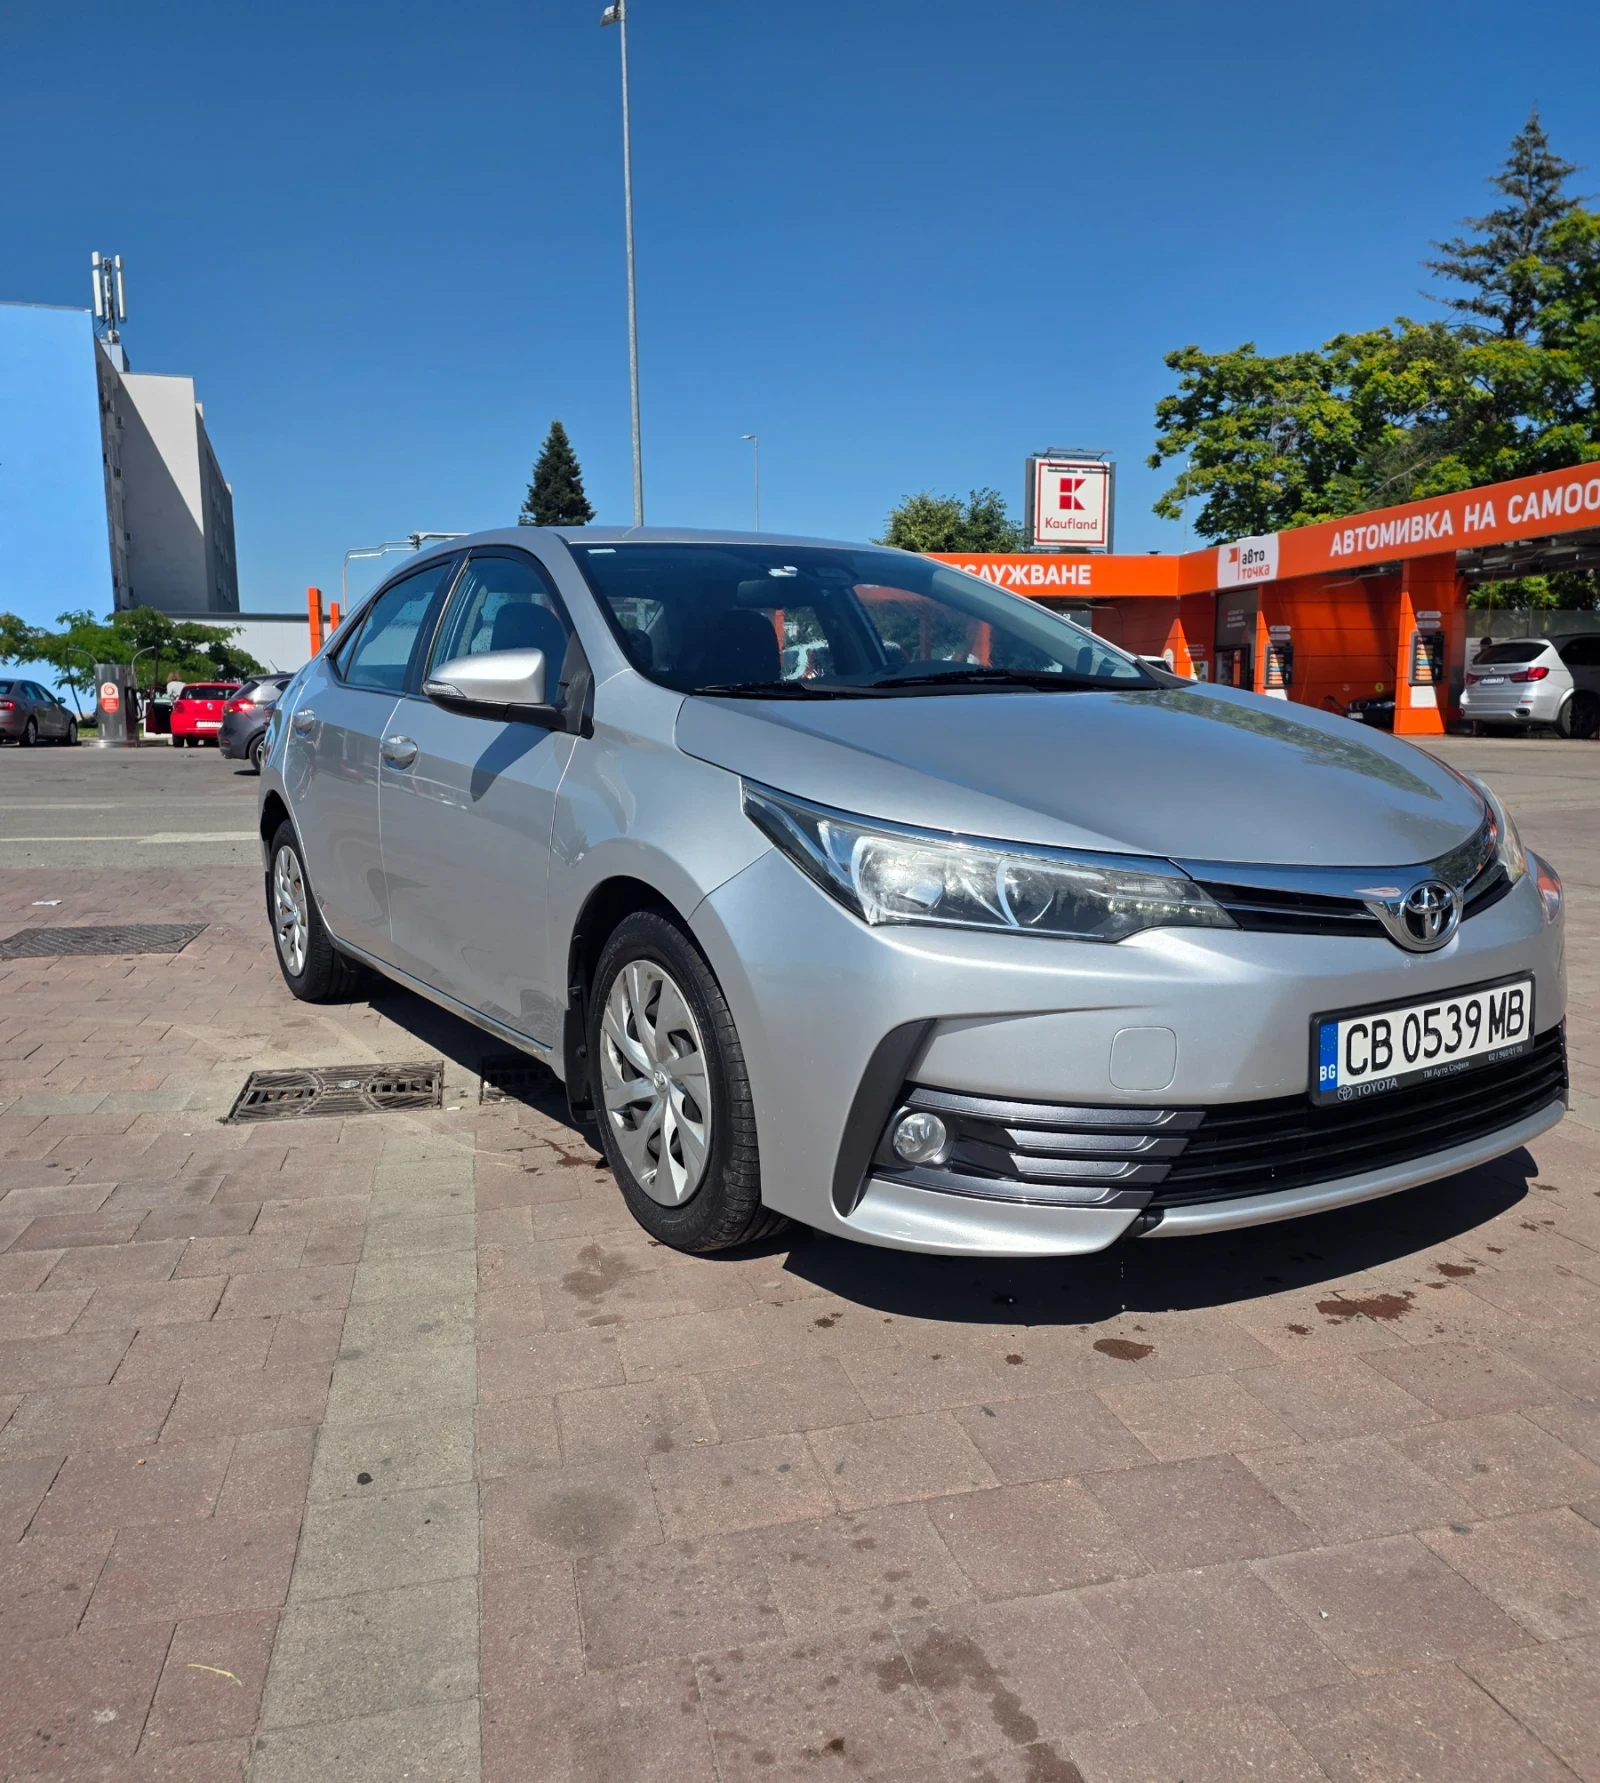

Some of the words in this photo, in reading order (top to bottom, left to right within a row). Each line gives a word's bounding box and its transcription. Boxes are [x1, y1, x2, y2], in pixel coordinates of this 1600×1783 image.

[1045, 516, 1098, 531] Kaufland
[1329, 508, 1454, 557] АВТОМИВКА
[1463, 500, 1497, 533] НА
[1241, 548, 1265, 565] авто
[1241, 564, 1270, 580] точка
[1345, 1018, 1394, 1076] CB
[1402, 999, 1483, 1063] 0539
[1488, 988, 1525, 1044] MB
[1319, 1063, 1336, 1082] BG
[1356, 1077, 1398, 1097] TOYOTA
